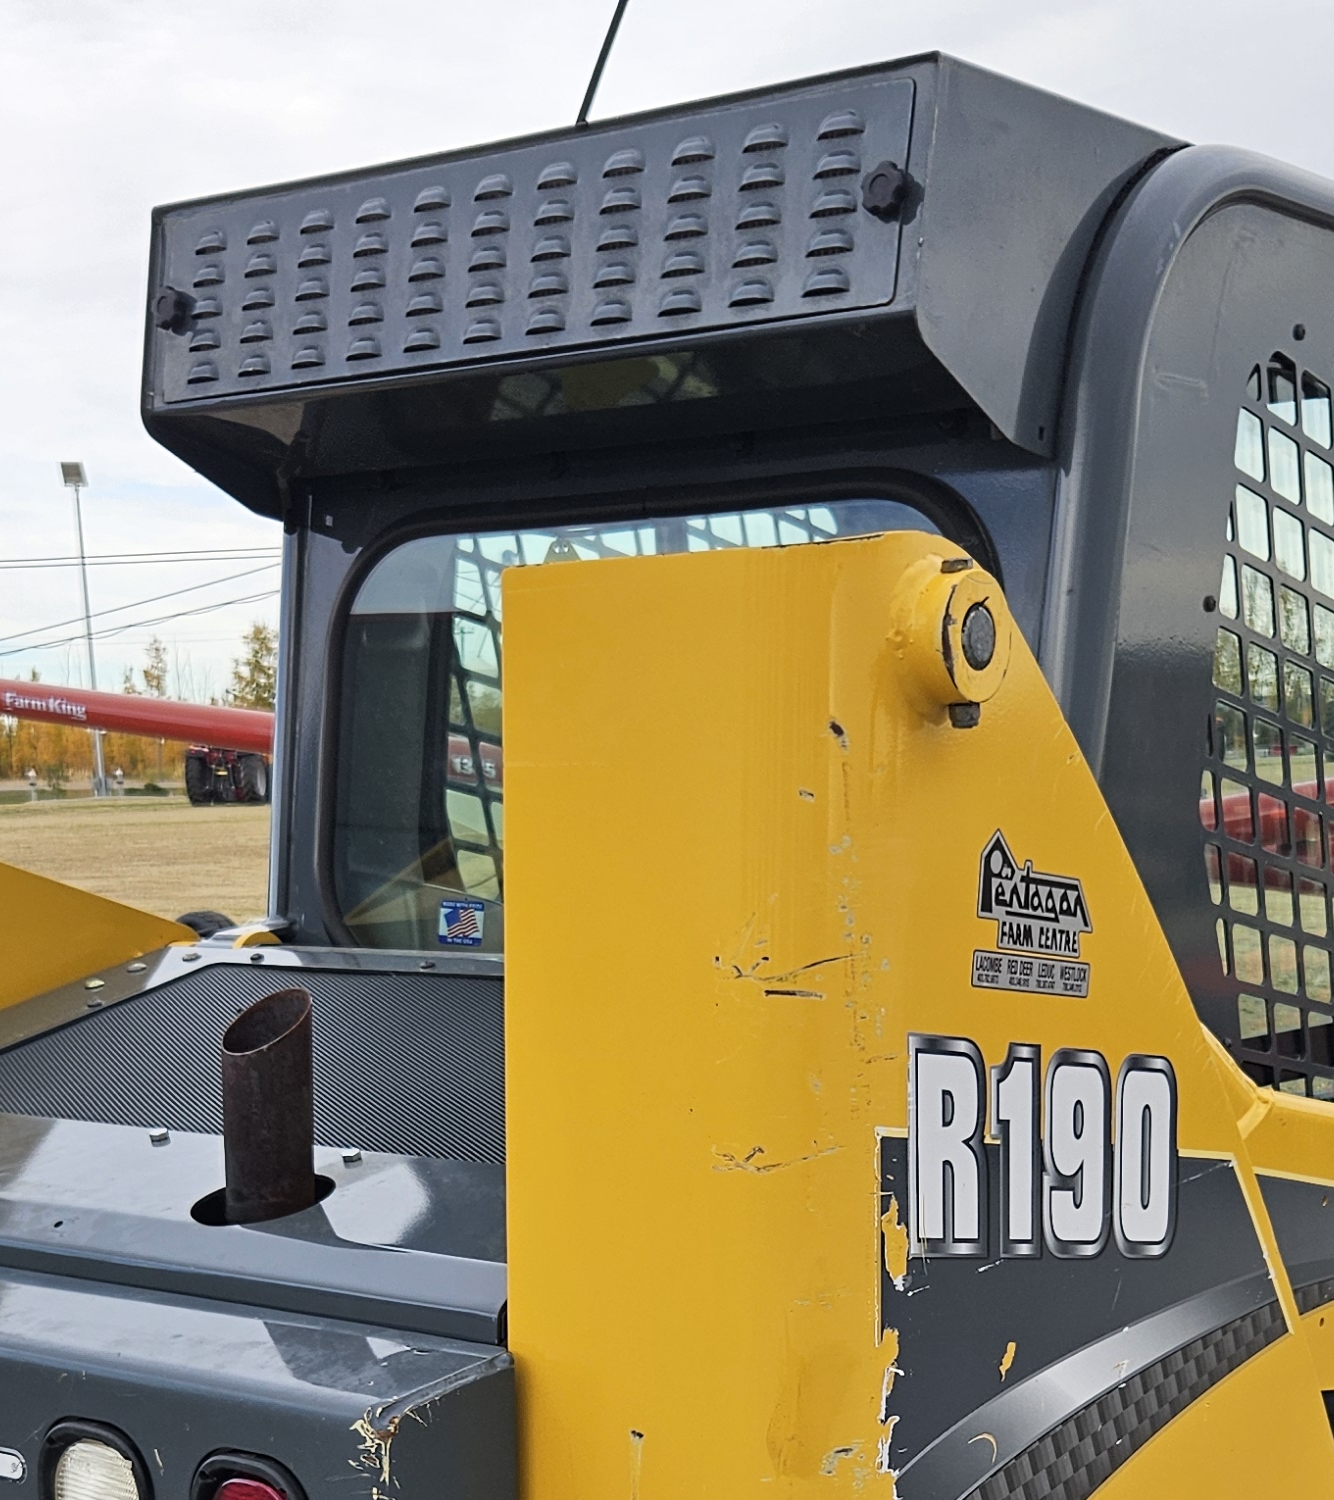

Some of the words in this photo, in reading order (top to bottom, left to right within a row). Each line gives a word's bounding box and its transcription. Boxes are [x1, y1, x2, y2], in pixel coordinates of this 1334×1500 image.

[5, 691, 47, 711] Farm
[48, 697, 87, 720] King
[452, 756, 496, 779] 135
[1000, 921, 1033, 948] FARM
[1038, 926, 1078, 953] CENTRE
[907, 1032, 1179, 1259] R190
